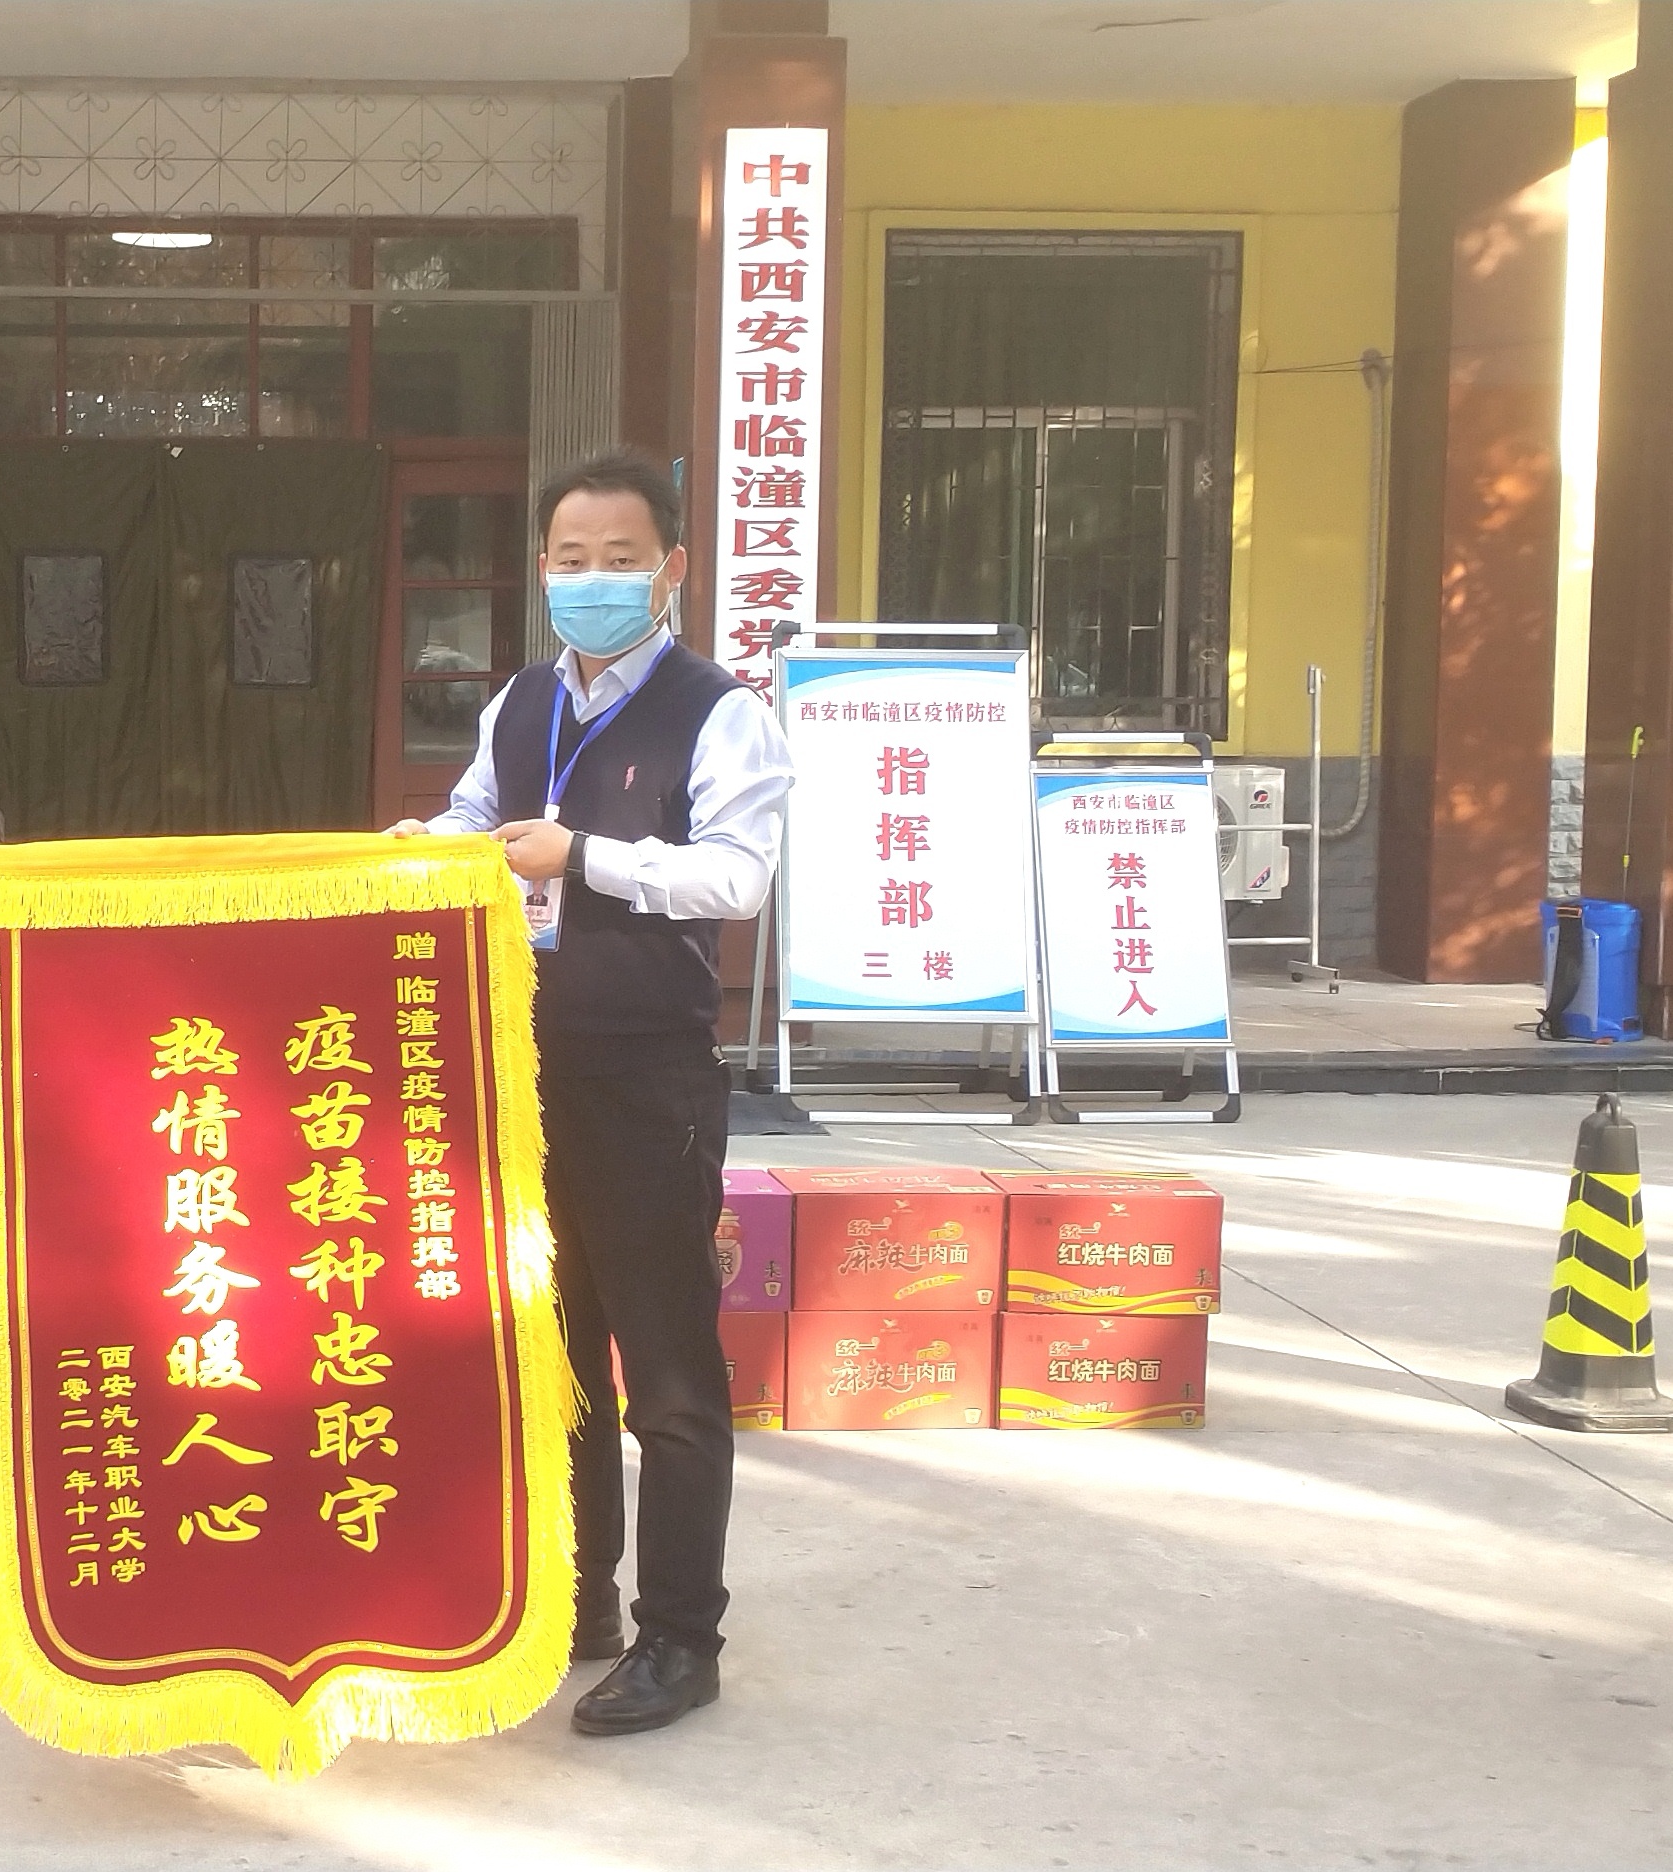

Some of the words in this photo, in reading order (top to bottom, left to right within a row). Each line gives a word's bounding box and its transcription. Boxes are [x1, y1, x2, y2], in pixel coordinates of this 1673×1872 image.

[800, 701, 1006, 723] 西安市临潼区疫情防控
[875, 746, 933, 928] 指挥部
[1064, 817, 1186, 836] 疫情防控指挥部
[1071, 794, 1175, 810] 西安市临潼区
[1106, 852, 1158, 1017] 禁止进入
[149, 1016, 273, 1545] 热情服务暖人心
[284, 1005, 399, 1553] 疫苗接种忠职守
[1057, 1243, 1175, 1266] 红烧牛肉面
[1047, 1359, 1161, 1382] 红烧牛肉面
[57, 1347, 99, 1587] 二零二一年十二月
[97, 1345, 146, 1584] 西安汽车职业大学
